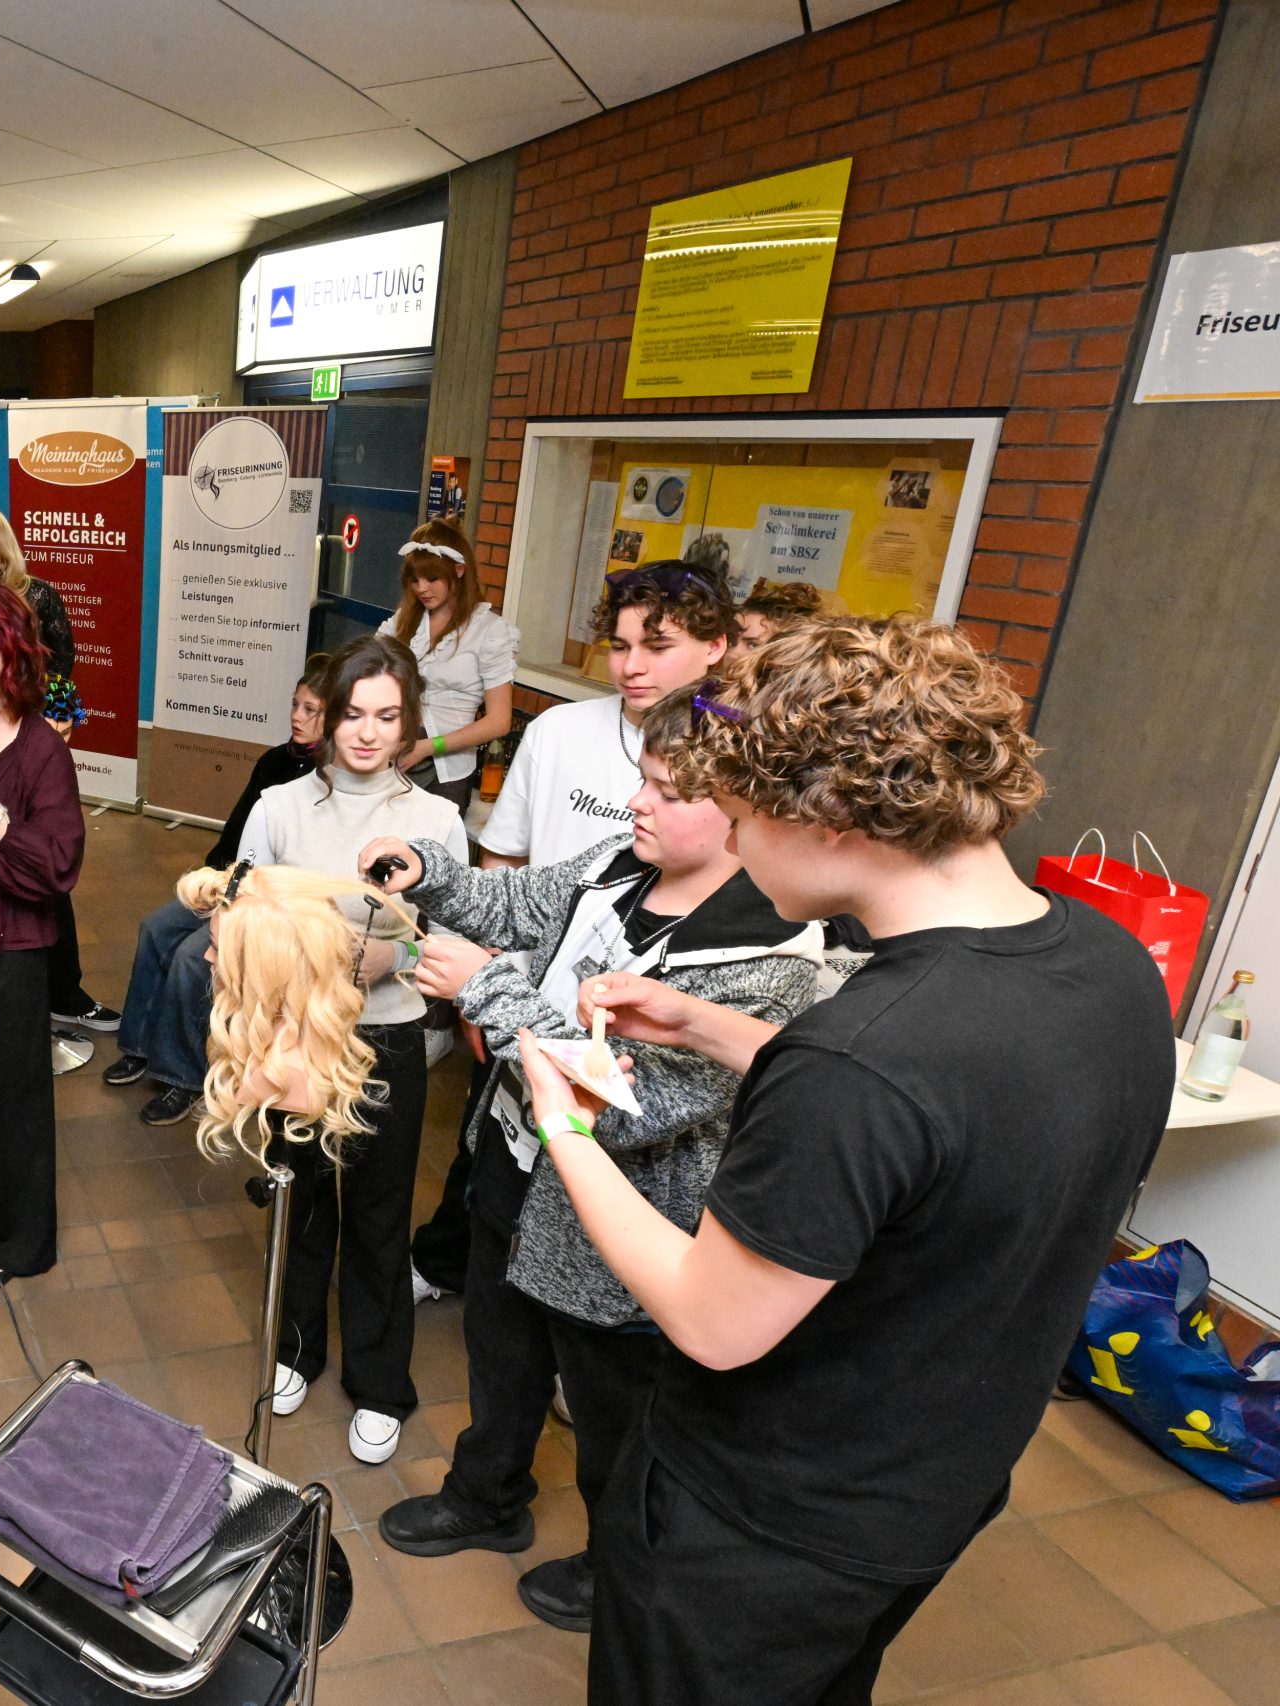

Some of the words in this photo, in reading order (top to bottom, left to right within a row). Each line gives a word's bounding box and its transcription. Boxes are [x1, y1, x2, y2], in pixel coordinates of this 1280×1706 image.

[303, 264, 425, 307] VERWALTUNG
[27, 439, 126, 476] Meininghaus
[217, 461, 283, 477] FRISEURINNUNG
[24, 511, 90, 527] SCHNELL
[93, 513, 105, 527] &
[769, 507, 791, 517] Schon
[792, 510, 806, 518] von
[807, 512, 840, 521] unserer
[24, 527, 126, 546] ERFOLGREICH
[764, 521, 837, 540] Schulimkerei
[173, 540, 190, 551] Als
[192, 540, 282, 557] Innungsmitglied
[770, 546, 787, 556] am
[789, 545, 820, 560] SBSZ
[23, 550, 48, 562] ZUM
[50, 552, 94, 565] FRISEUR
[777, 564, 806, 576] gehört?
[47, 581, 86, 592] BILDUNG
[182, 573, 226, 585] genießen
[227, 576, 242, 586] Sie
[243, 578, 288, 590] exklusive
[60, 595, 102, 605] NSTEIGER
[181, 590, 234, 605] Leistungen
[68, 619, 96, 629] HUNG
[180, 613, 215, 624] werden
[217, 614, 232, 626] Sie
[233, 616, 248, 628] top
[249, 618, 300, 632] informiert
[179, 633, 199, 644] sind
[200, 634, 215, 645] Sie
[216, 638, 245, 649] immer
[247, 641, 273, 652] einen
[178, 649, 212, 662] Schnitt
[213, 655, 244, 666] voraus
[177, 671, 209, 683] sparen
[210, 674, 224, 685] Sie
[226, 676, 247, 688] Geld
[166, 699, 211, 714] Kommen
[212, 705, 229, 717] Sie
[230, 710, 243, 720] zu
[245, 713, 268, 723] uns!
[75, 762, 112, 775] ghaus.de
